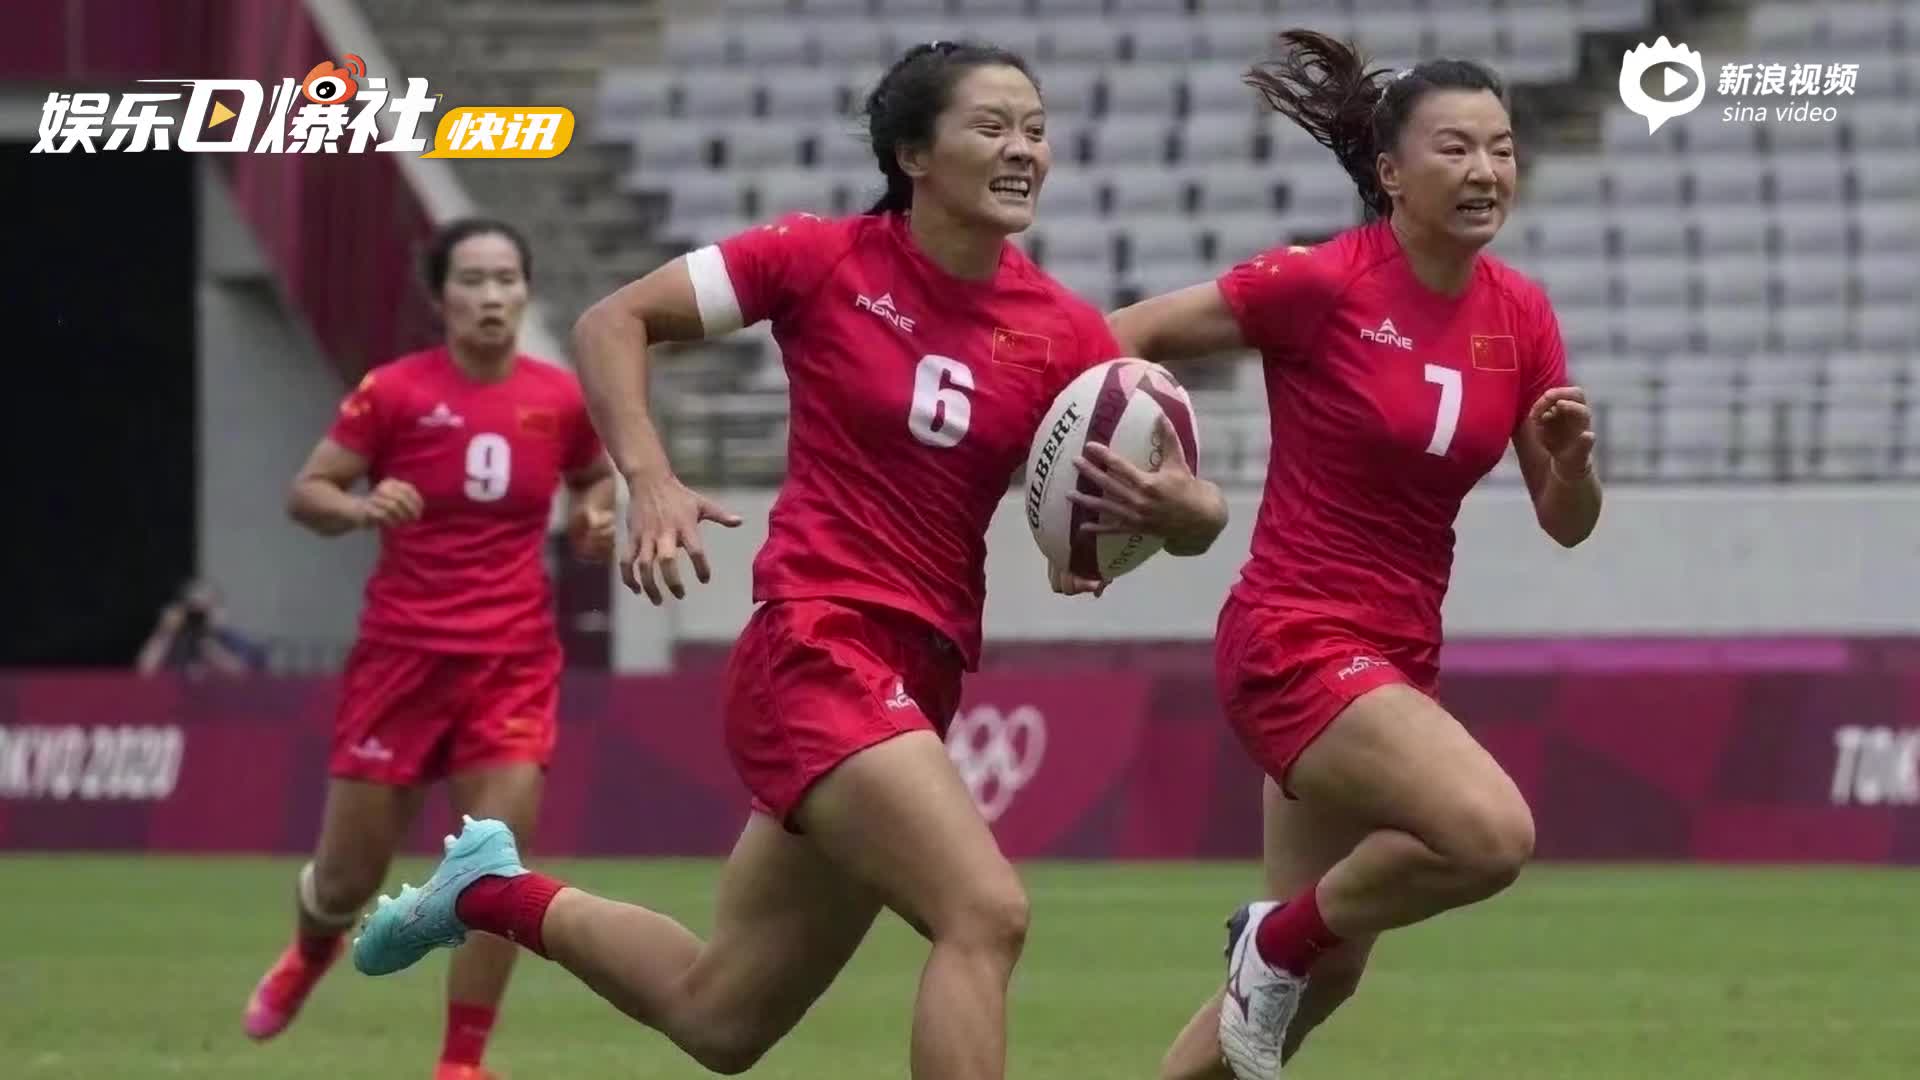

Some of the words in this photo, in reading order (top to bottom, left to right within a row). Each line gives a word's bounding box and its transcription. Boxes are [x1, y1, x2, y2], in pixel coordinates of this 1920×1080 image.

[908, 354, 976, 448] 6
[1424, 363, 1463, 457] 7
[464, 431, 512, 503] 9
[1026, 402, 1081, 529] GILBERT
[81, 724, 186, 800] 2020
